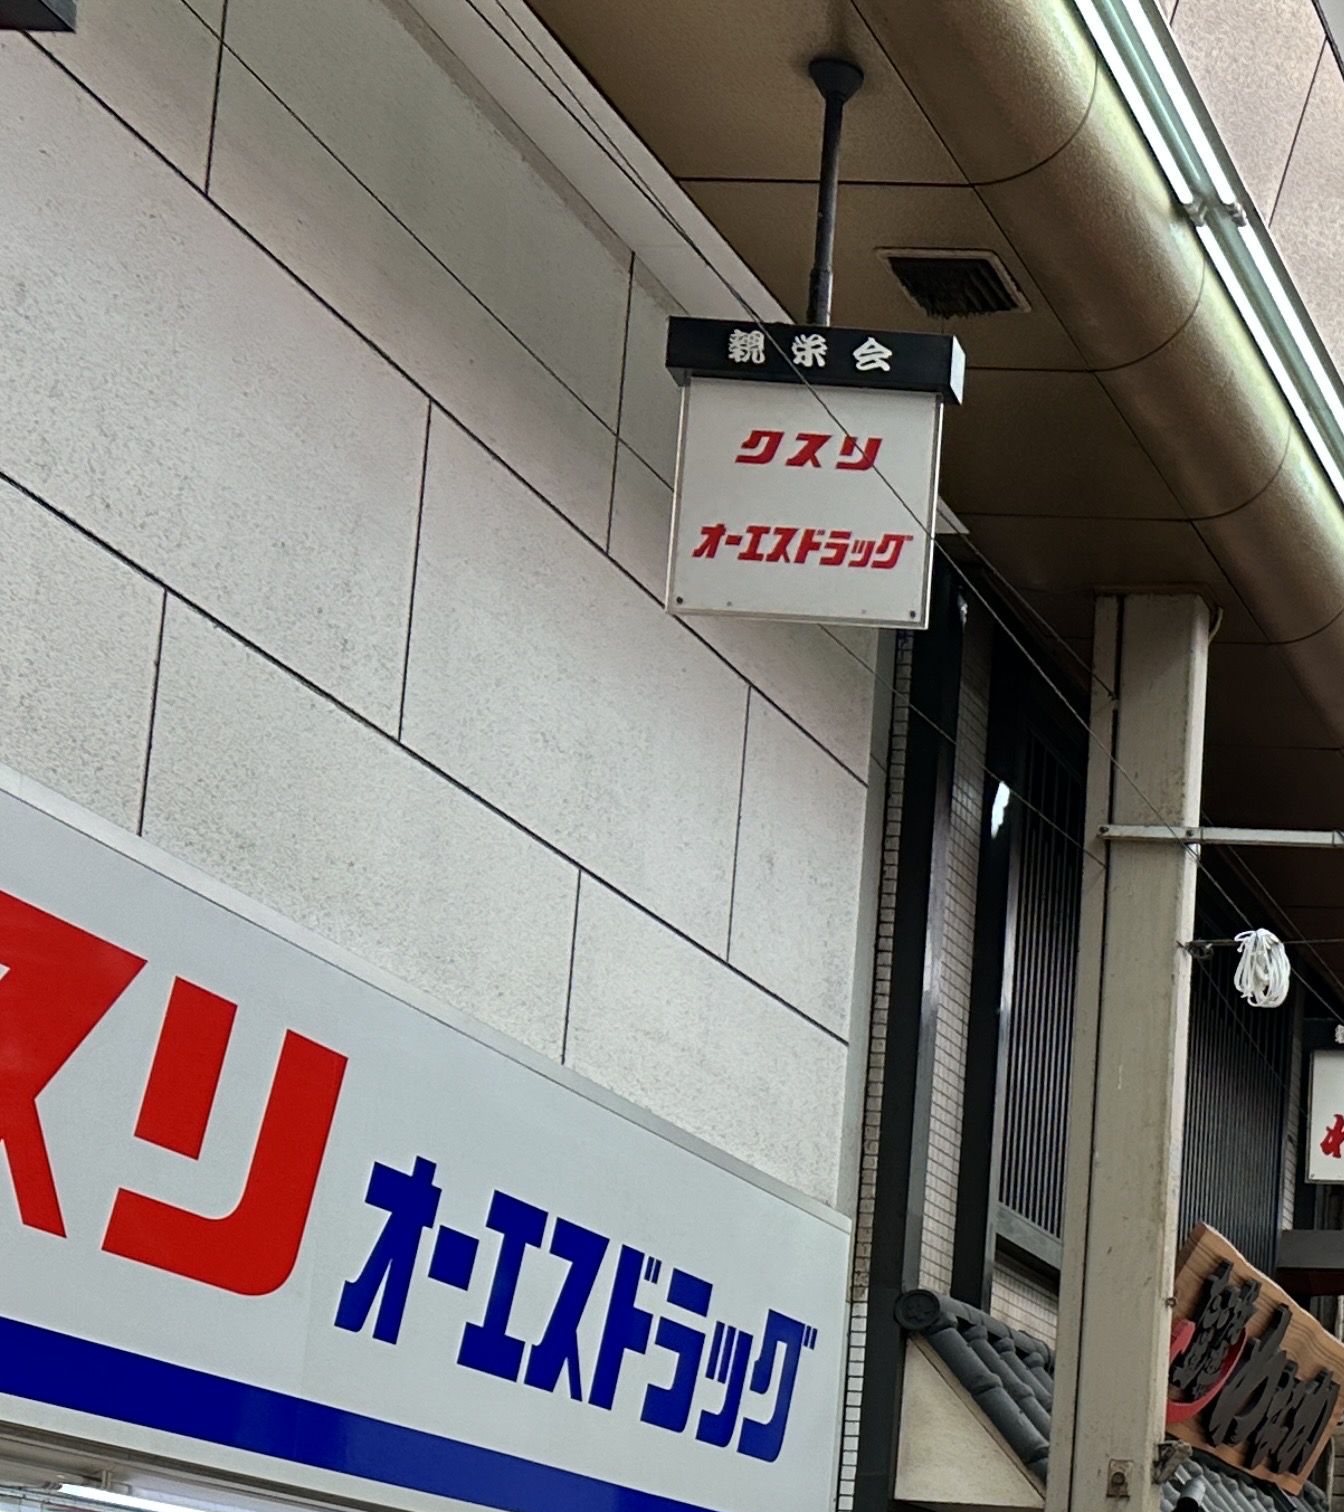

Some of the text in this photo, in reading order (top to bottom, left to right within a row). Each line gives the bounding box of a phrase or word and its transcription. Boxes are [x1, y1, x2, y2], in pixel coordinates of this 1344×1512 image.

[728, 329, 892, 372] 親栄会
[735, 429, 882, 471] クスリ
[692, 523, 913, 569] オーエスドラッグ
[334, 1156, 818, 1463] オーエスドラッグ
